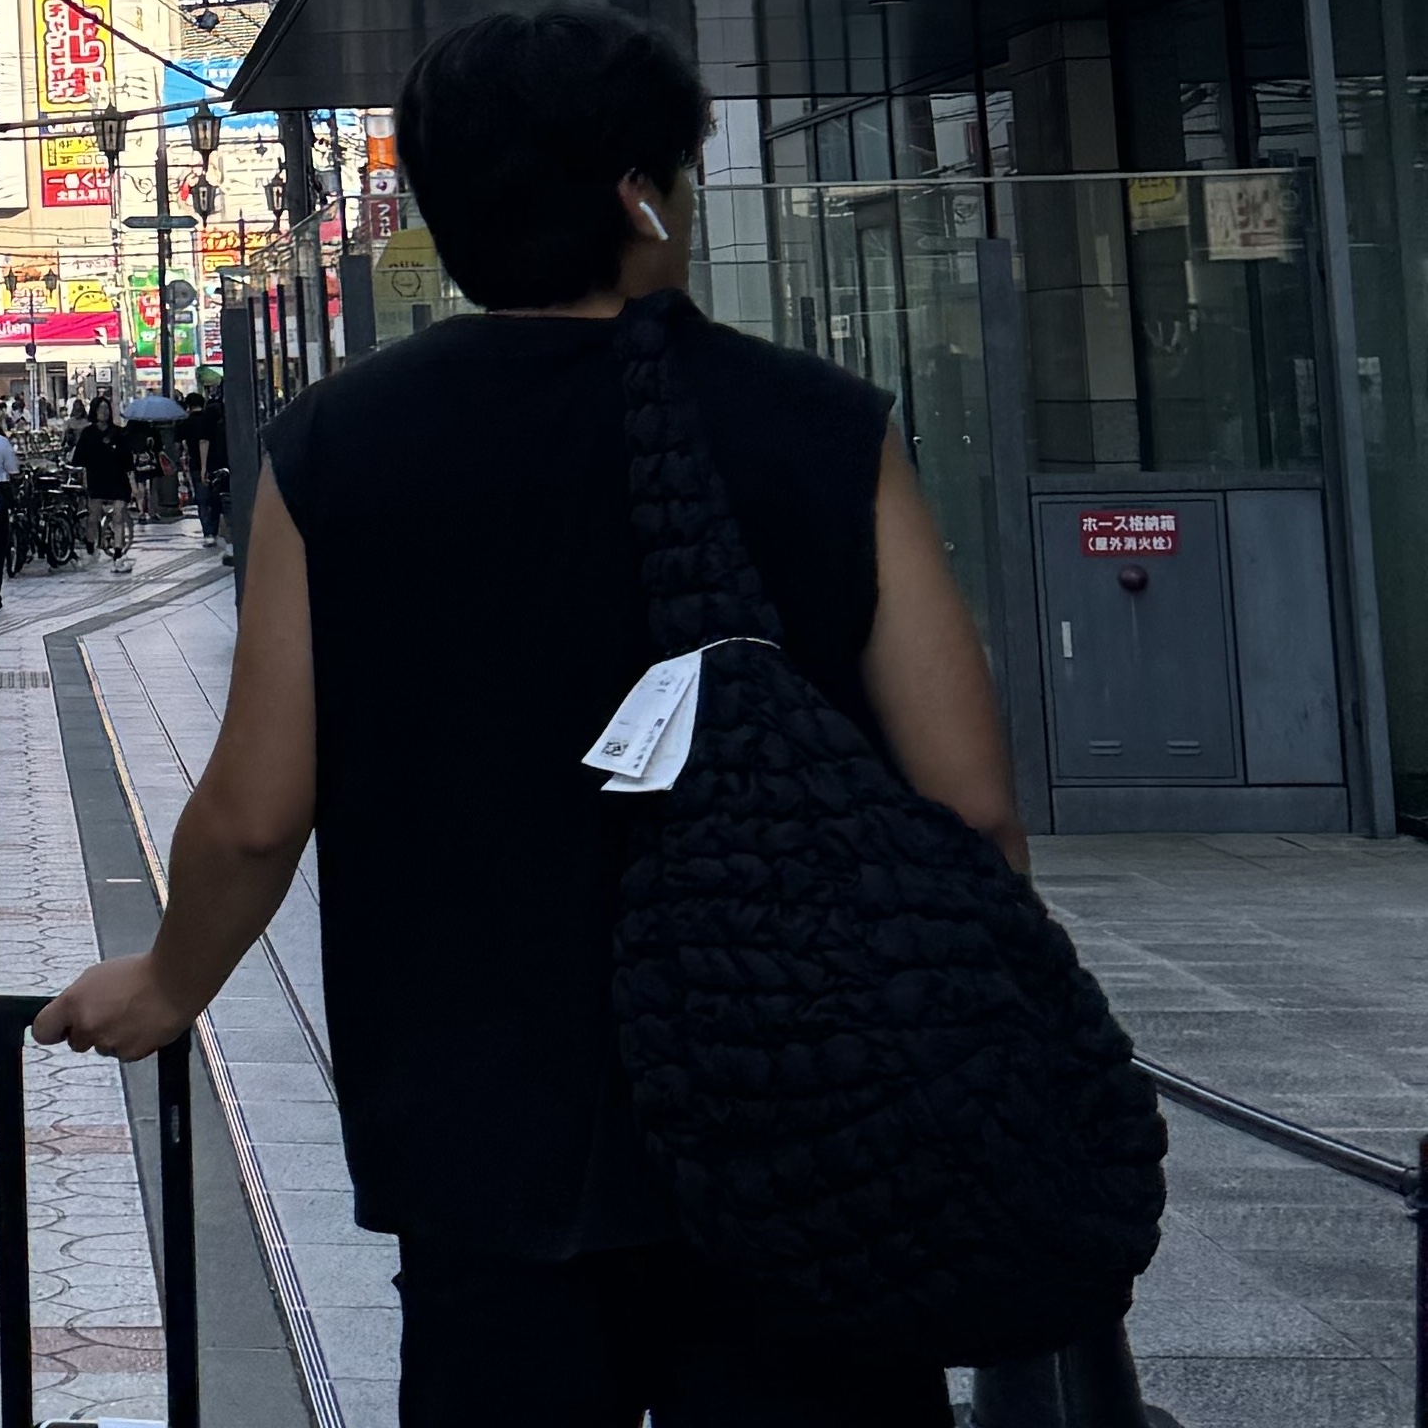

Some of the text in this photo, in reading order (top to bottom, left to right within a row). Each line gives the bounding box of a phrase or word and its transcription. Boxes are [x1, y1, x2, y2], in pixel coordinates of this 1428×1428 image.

[1082, 515, 1176, 532] ホース格納箱
